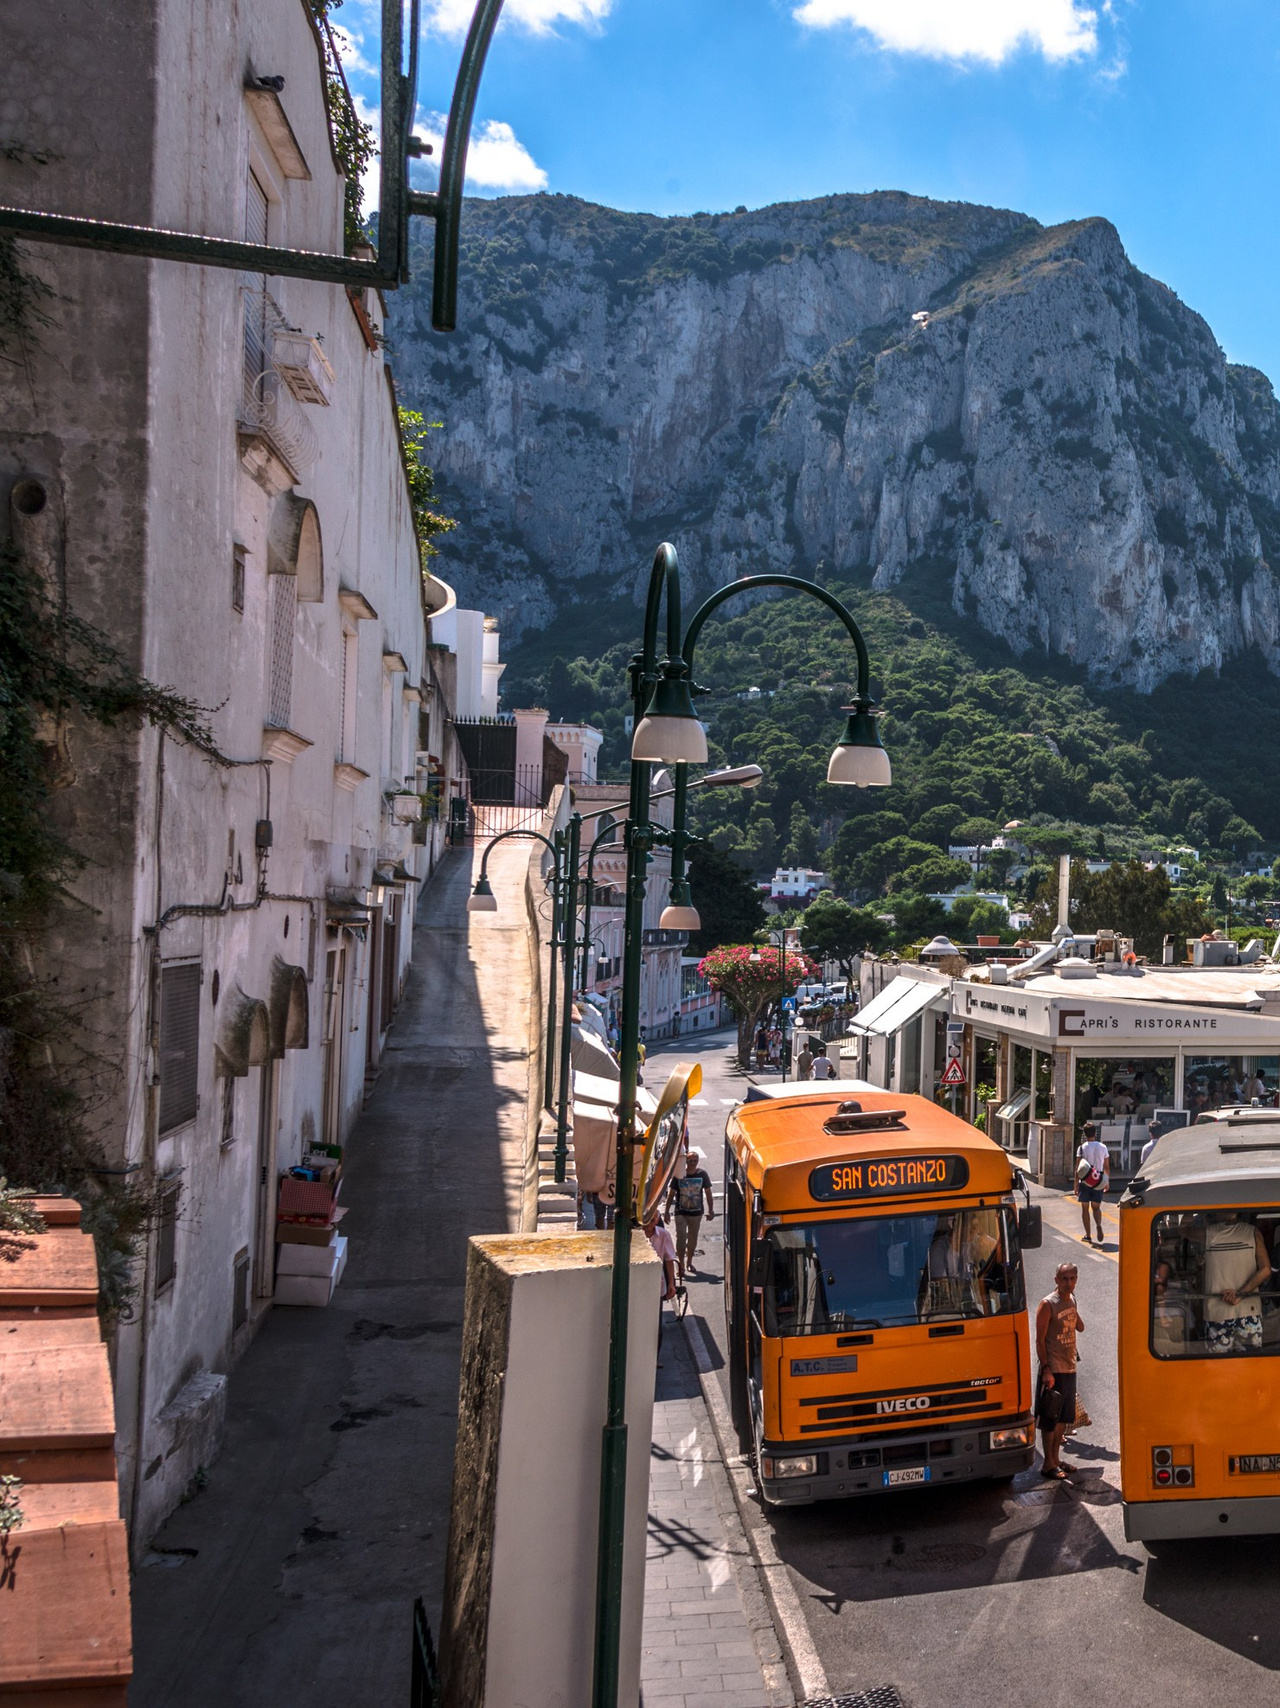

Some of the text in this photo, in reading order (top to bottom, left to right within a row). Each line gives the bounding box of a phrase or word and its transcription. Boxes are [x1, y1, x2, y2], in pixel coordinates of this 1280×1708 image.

[1135, 1019, 1217, 1029] RISTORANTE
[832, 1159, 946, 1191] SAN COSTANZO
[793, 1361, 824, 1373] A.T.C.
[970, 1377, 1000, 1386] tector
[876, 1396, 931, 1414] IVECO
